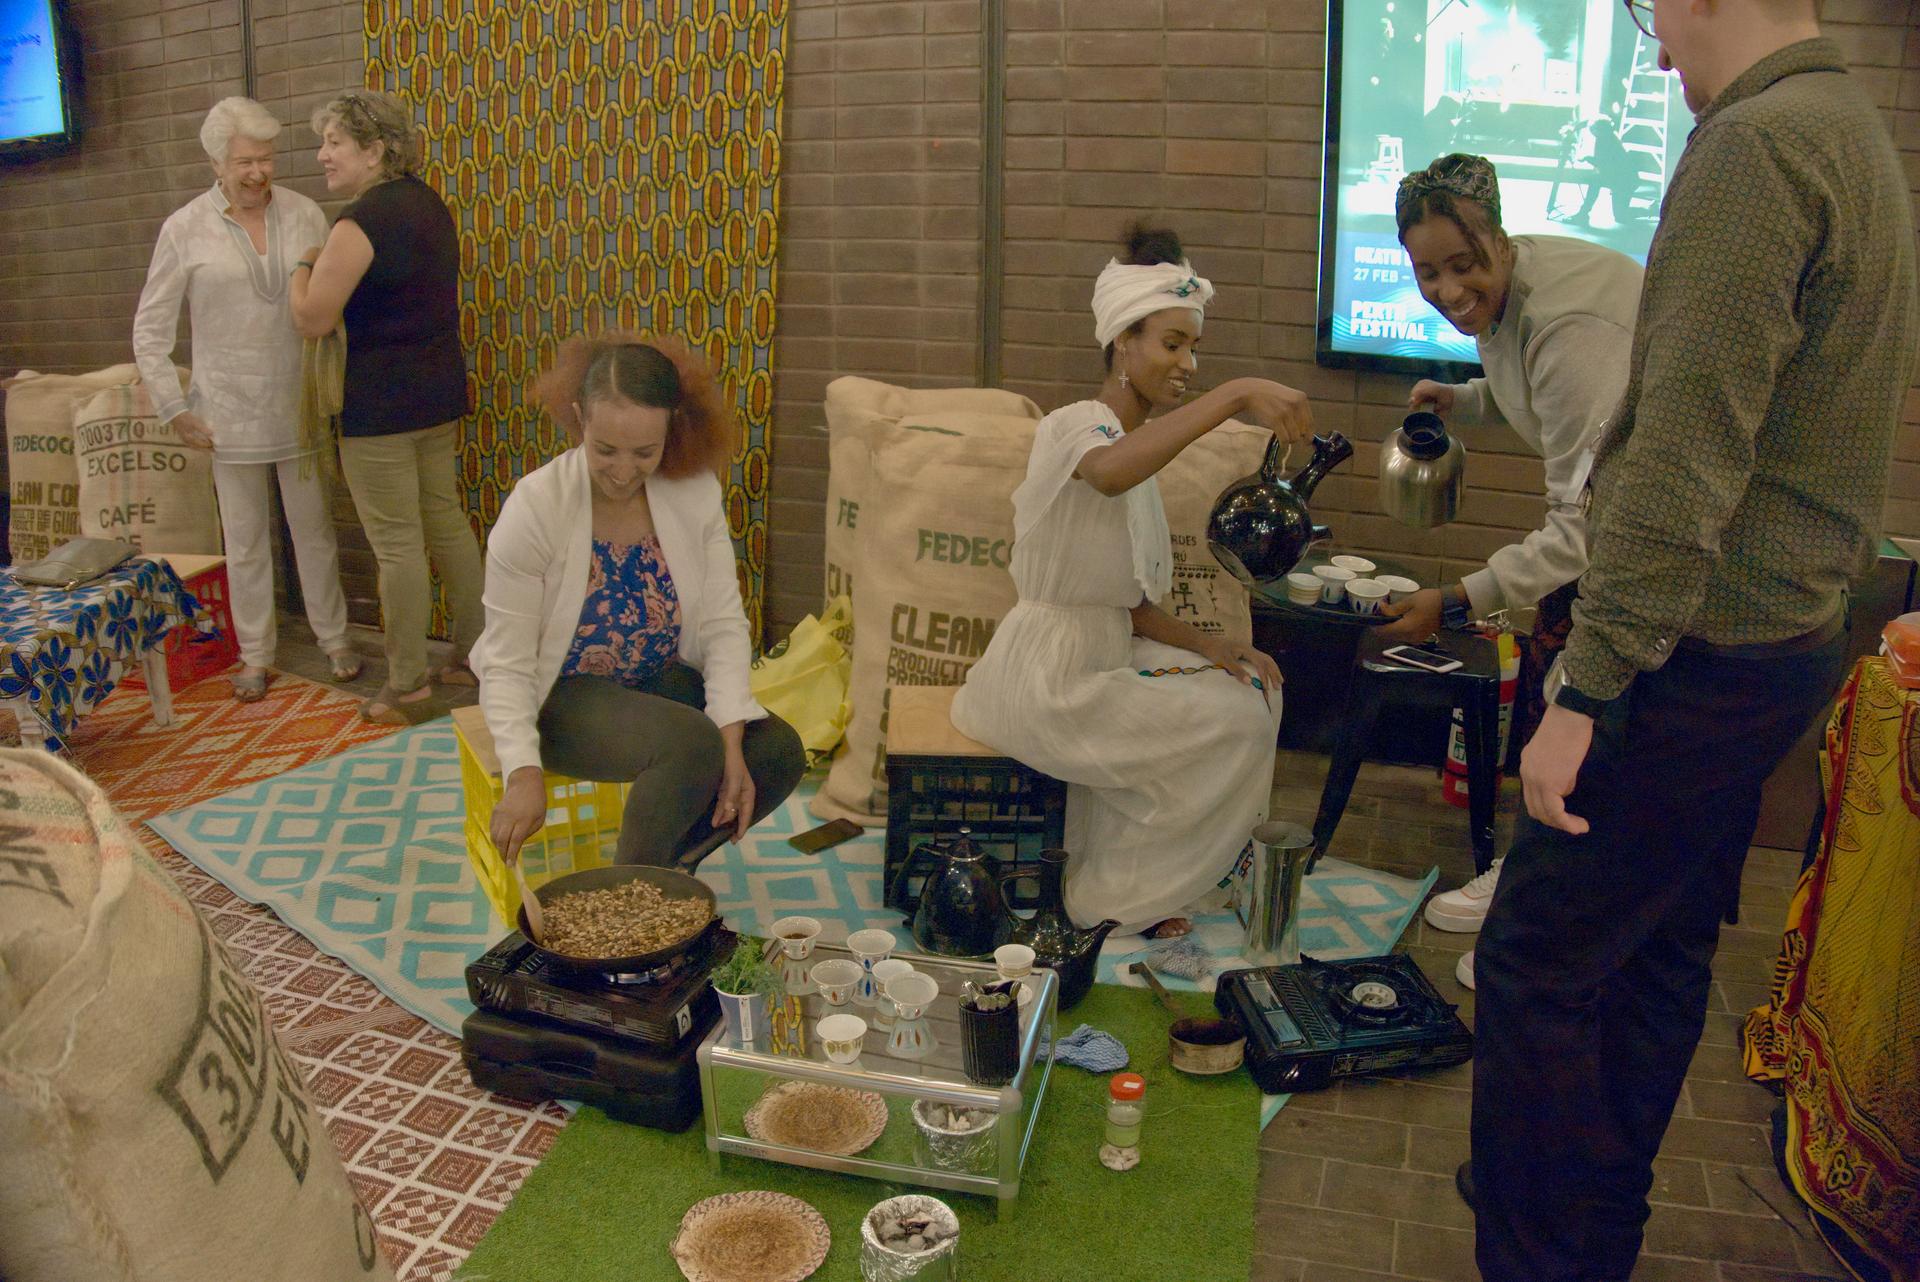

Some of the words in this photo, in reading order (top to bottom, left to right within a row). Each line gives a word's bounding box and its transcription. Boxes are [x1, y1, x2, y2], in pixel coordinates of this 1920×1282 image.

[1353, 268, 1369, 281] 27
[1373, 269, 1398, 283] FEB
[1351, 300, 1407, 321] PERTH
[1350, 317, 1428, 340] FESTIVAL
[87, 450, 187, 478] EXCELSO
[99, 497, 156, 528] CAFÉ
[890, 602, 997, 658] CLEAN
